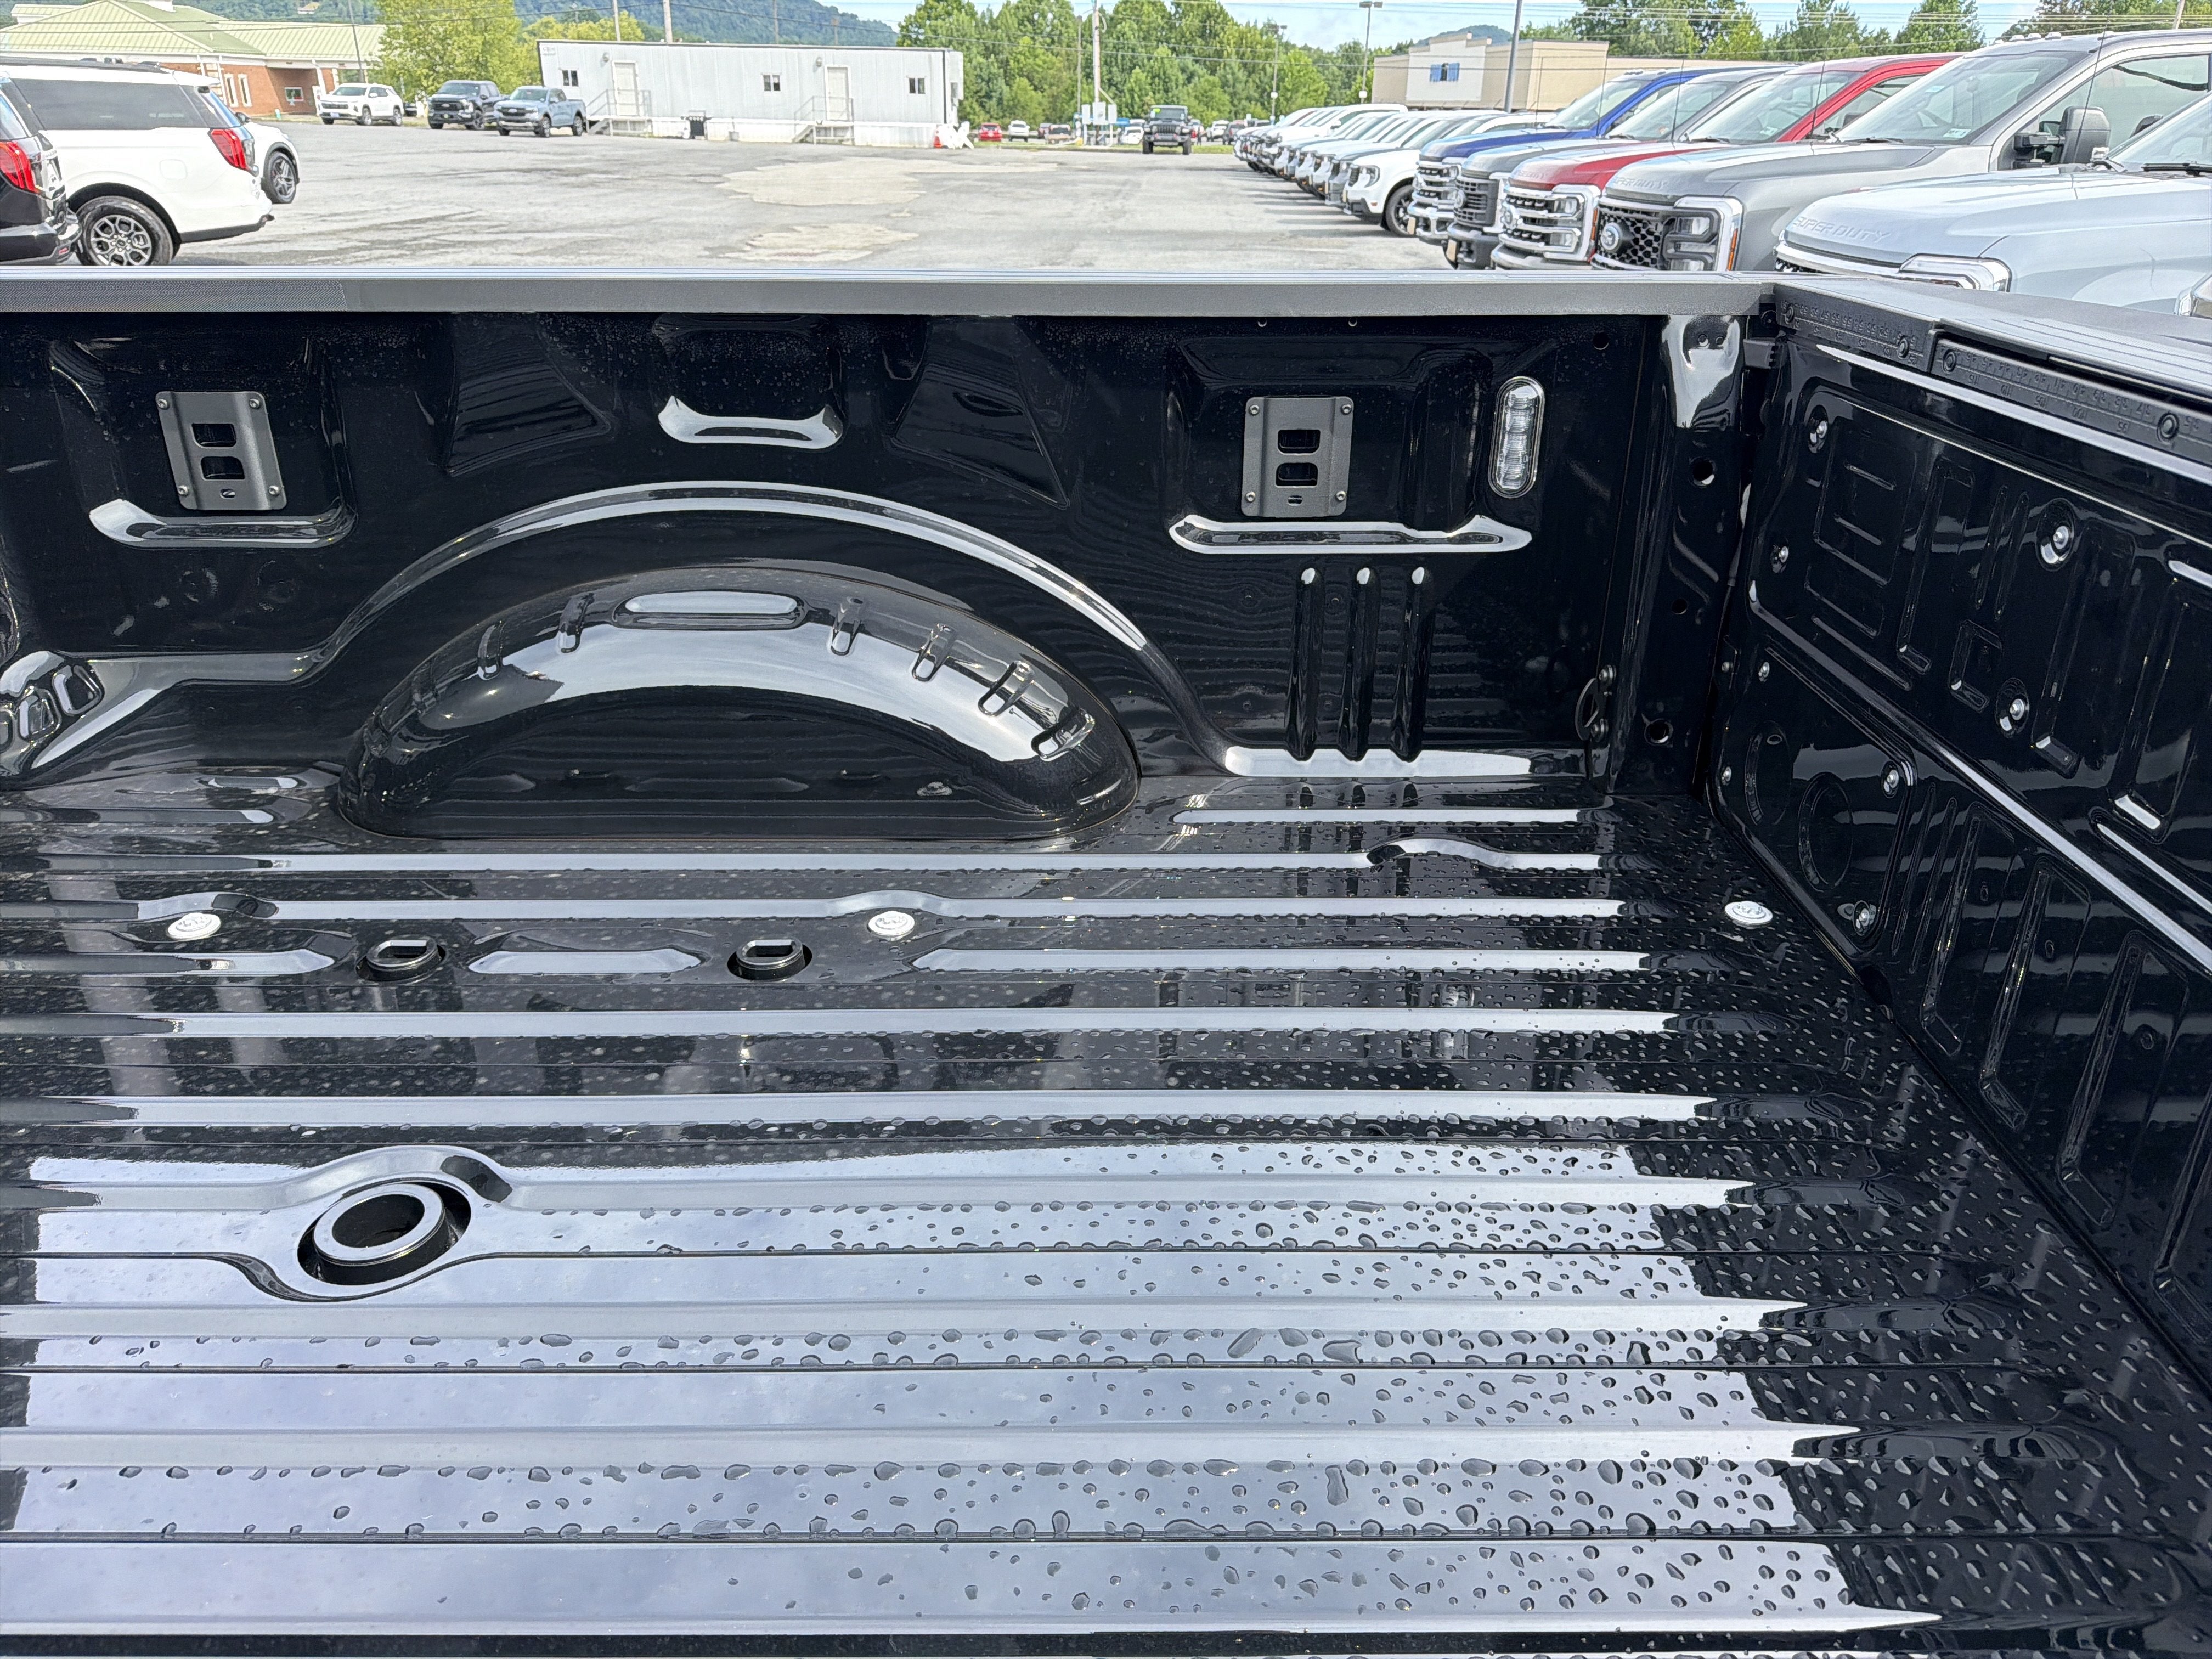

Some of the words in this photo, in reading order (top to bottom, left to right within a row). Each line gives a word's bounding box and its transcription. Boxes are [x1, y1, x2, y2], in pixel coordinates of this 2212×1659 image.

[1832, 224, 1891, 243] DUTY
[1966, 352, 1977, 364] 46
[1982, 357, 1993, 369] 45
[1999, 362, 2011, 374] 44
[2016, 366, 2029, 379] 43
[2053, 378, 2067, 391] 41
[2072, 383, 2086, 396] 40
[2093, 389, 2107, 404] 39
[2136, 402, 2153, 417] 37
[2183, 416, 2200, 432] 35
